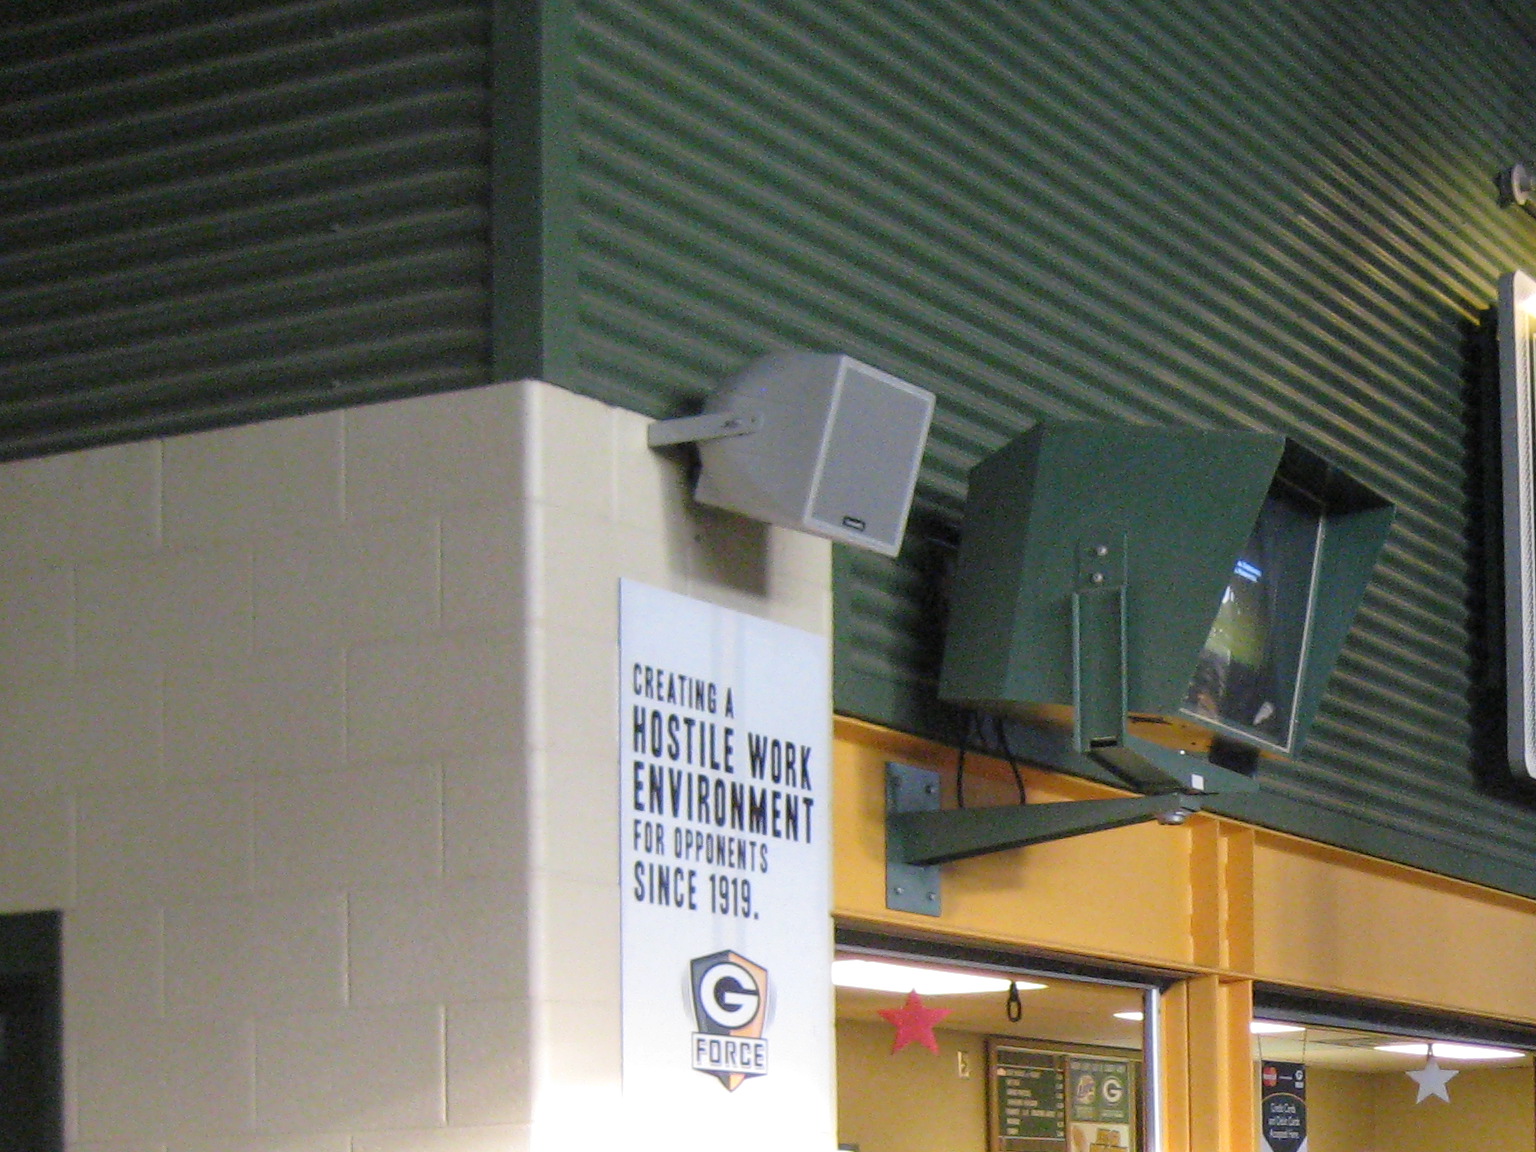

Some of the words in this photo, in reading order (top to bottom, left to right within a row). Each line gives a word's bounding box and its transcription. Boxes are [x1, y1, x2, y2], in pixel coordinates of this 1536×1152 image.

[633, 662, 717, 715] CREATING
[724, 687, 734, 718] A
[633, 705, 735, 774] HOSTILE
[748, 732, 812, 791] WORK
[633, 761, 813, 844] ENVIRONMENT
[633, 818, 665, 857] FOR
[674, 830, 769, 874] OPPONENTS
[633, 861, 697, 910] SINCE
[709, 874, 760, 919] 1919.
[699, 961, 761, 1028] G
[695, 1037, 765, 1070] FORCE
